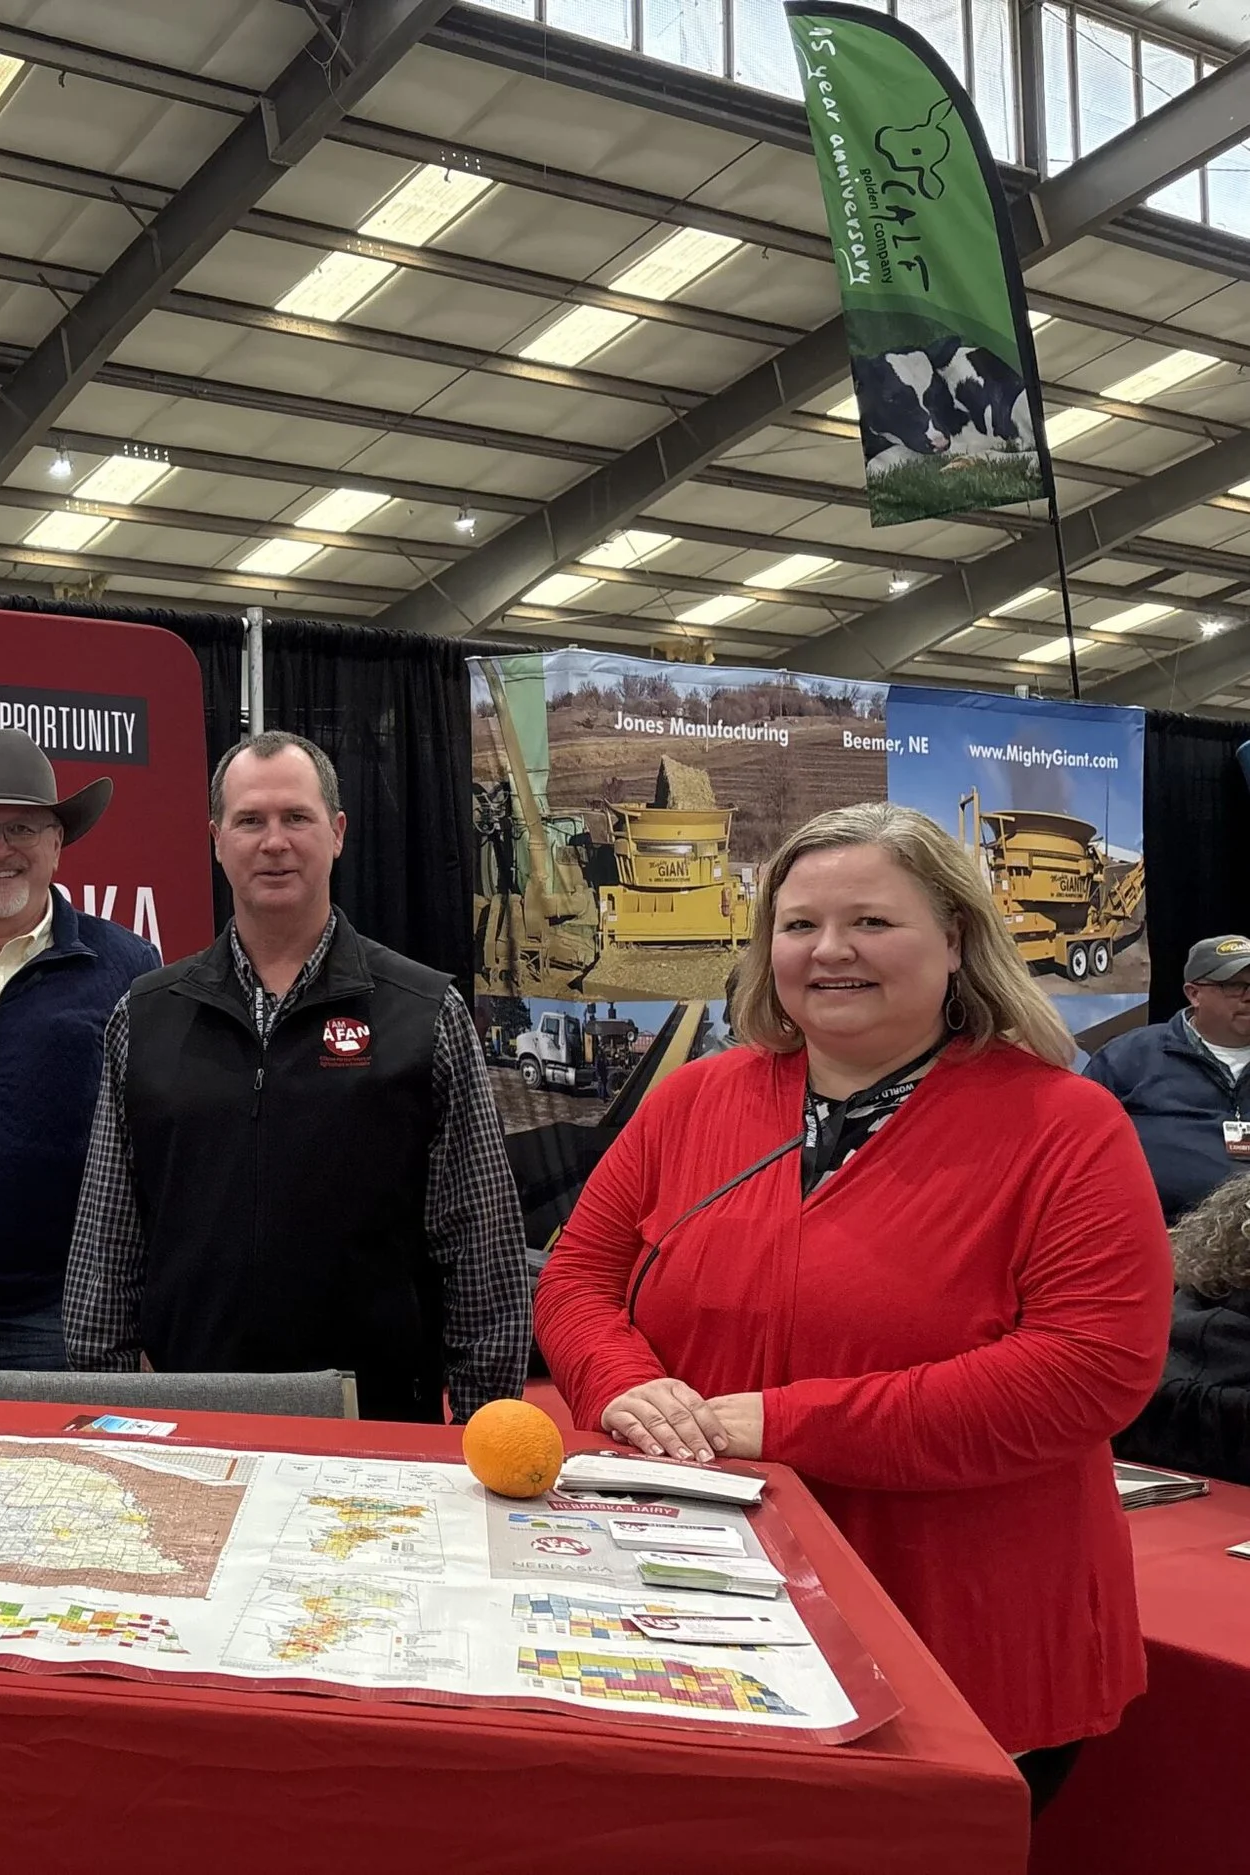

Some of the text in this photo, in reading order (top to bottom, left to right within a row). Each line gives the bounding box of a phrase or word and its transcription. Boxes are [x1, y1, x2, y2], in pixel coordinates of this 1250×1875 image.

[795, 26, 871, 287] 15 year anniversary
[859, 167, 894, 285] golden company
[614, 711, 930, 755] Jones Manufacturing Beemer, NE
[968, 741, 1119, 771] www.MightyGiant.com
[255, 987, 264, 1010] WORLD
[322, 1025, 370, 1042] A FAN
[881, 1082, 915, 1099] WORLD
[553, 1501, 673, 1514] NEBRASKA DAIRY
[511, 1561, 615, 1574] NEBRASKA
